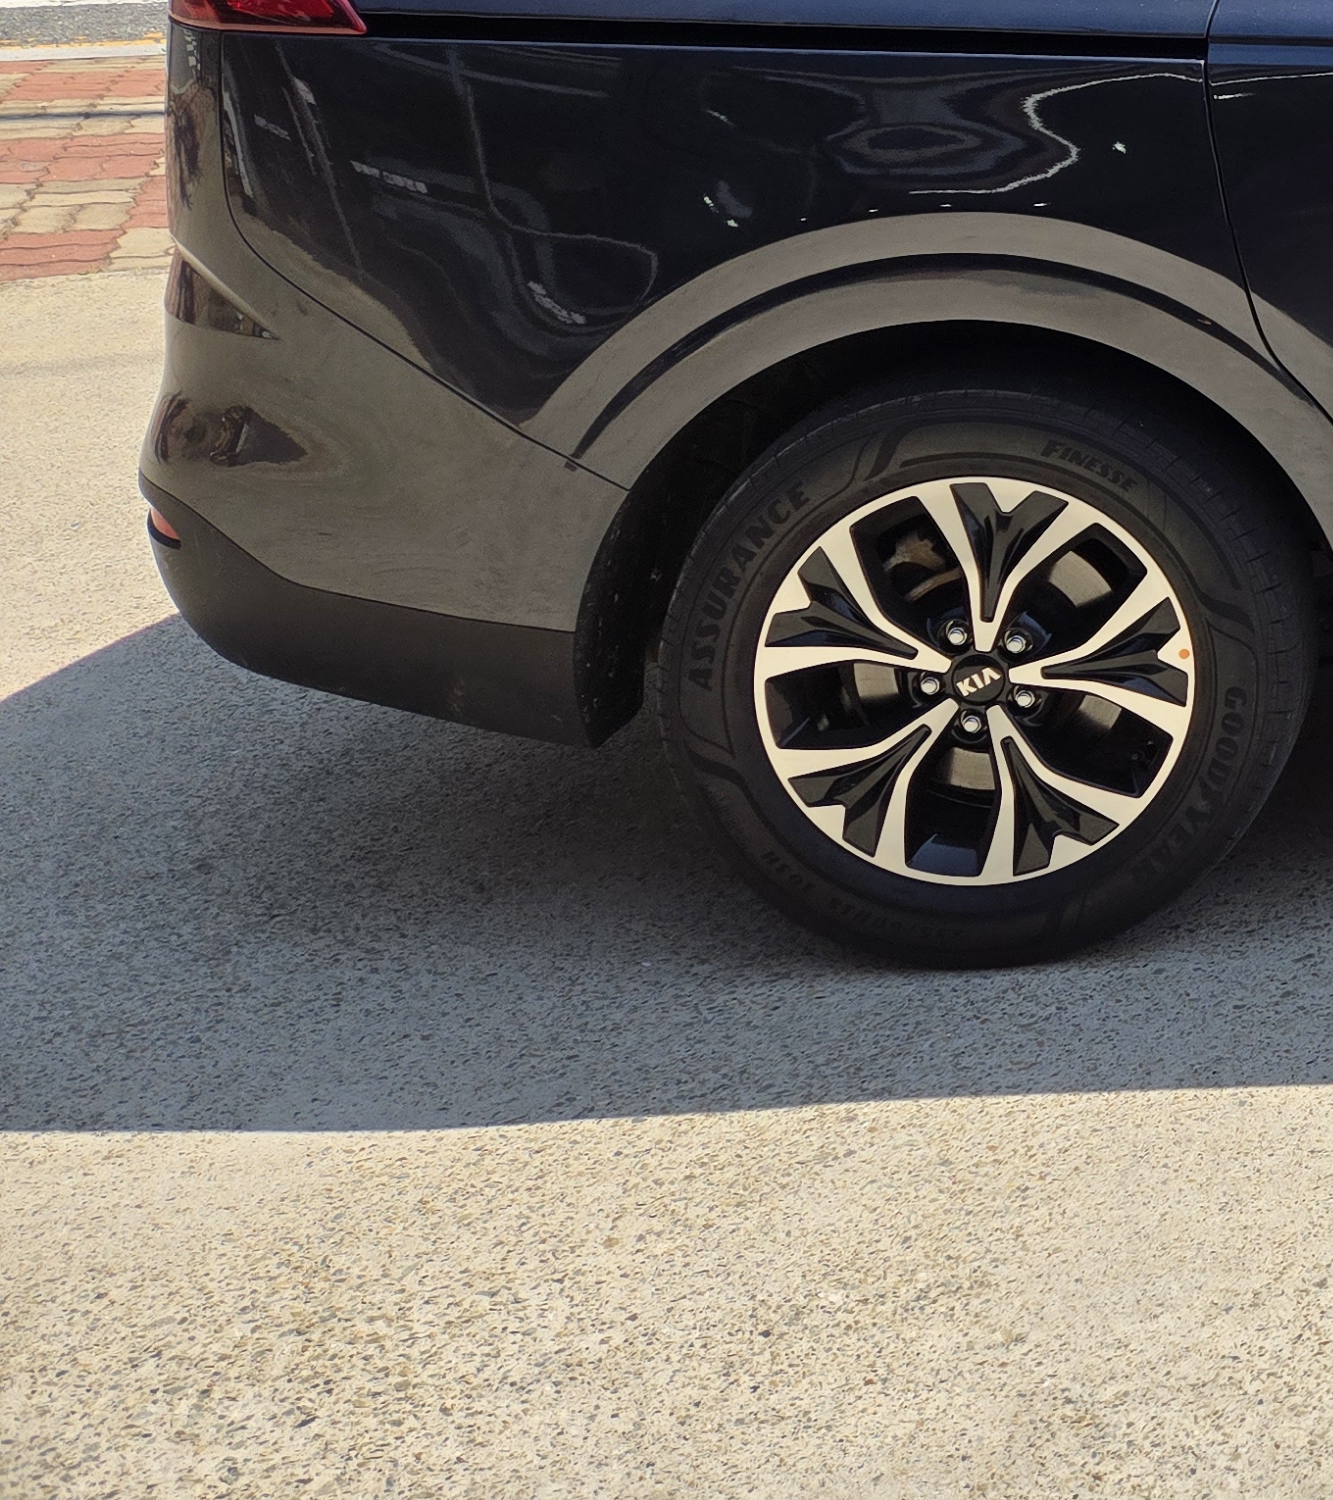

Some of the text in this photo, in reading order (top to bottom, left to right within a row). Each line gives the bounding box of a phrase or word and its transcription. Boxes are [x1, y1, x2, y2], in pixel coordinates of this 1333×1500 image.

[687, 438, 1138, 690] ASSURANCE FINESSE
[955, 666, 1002, 697] KIA
[1131, 684, 1249, 888] GOODYEAR
